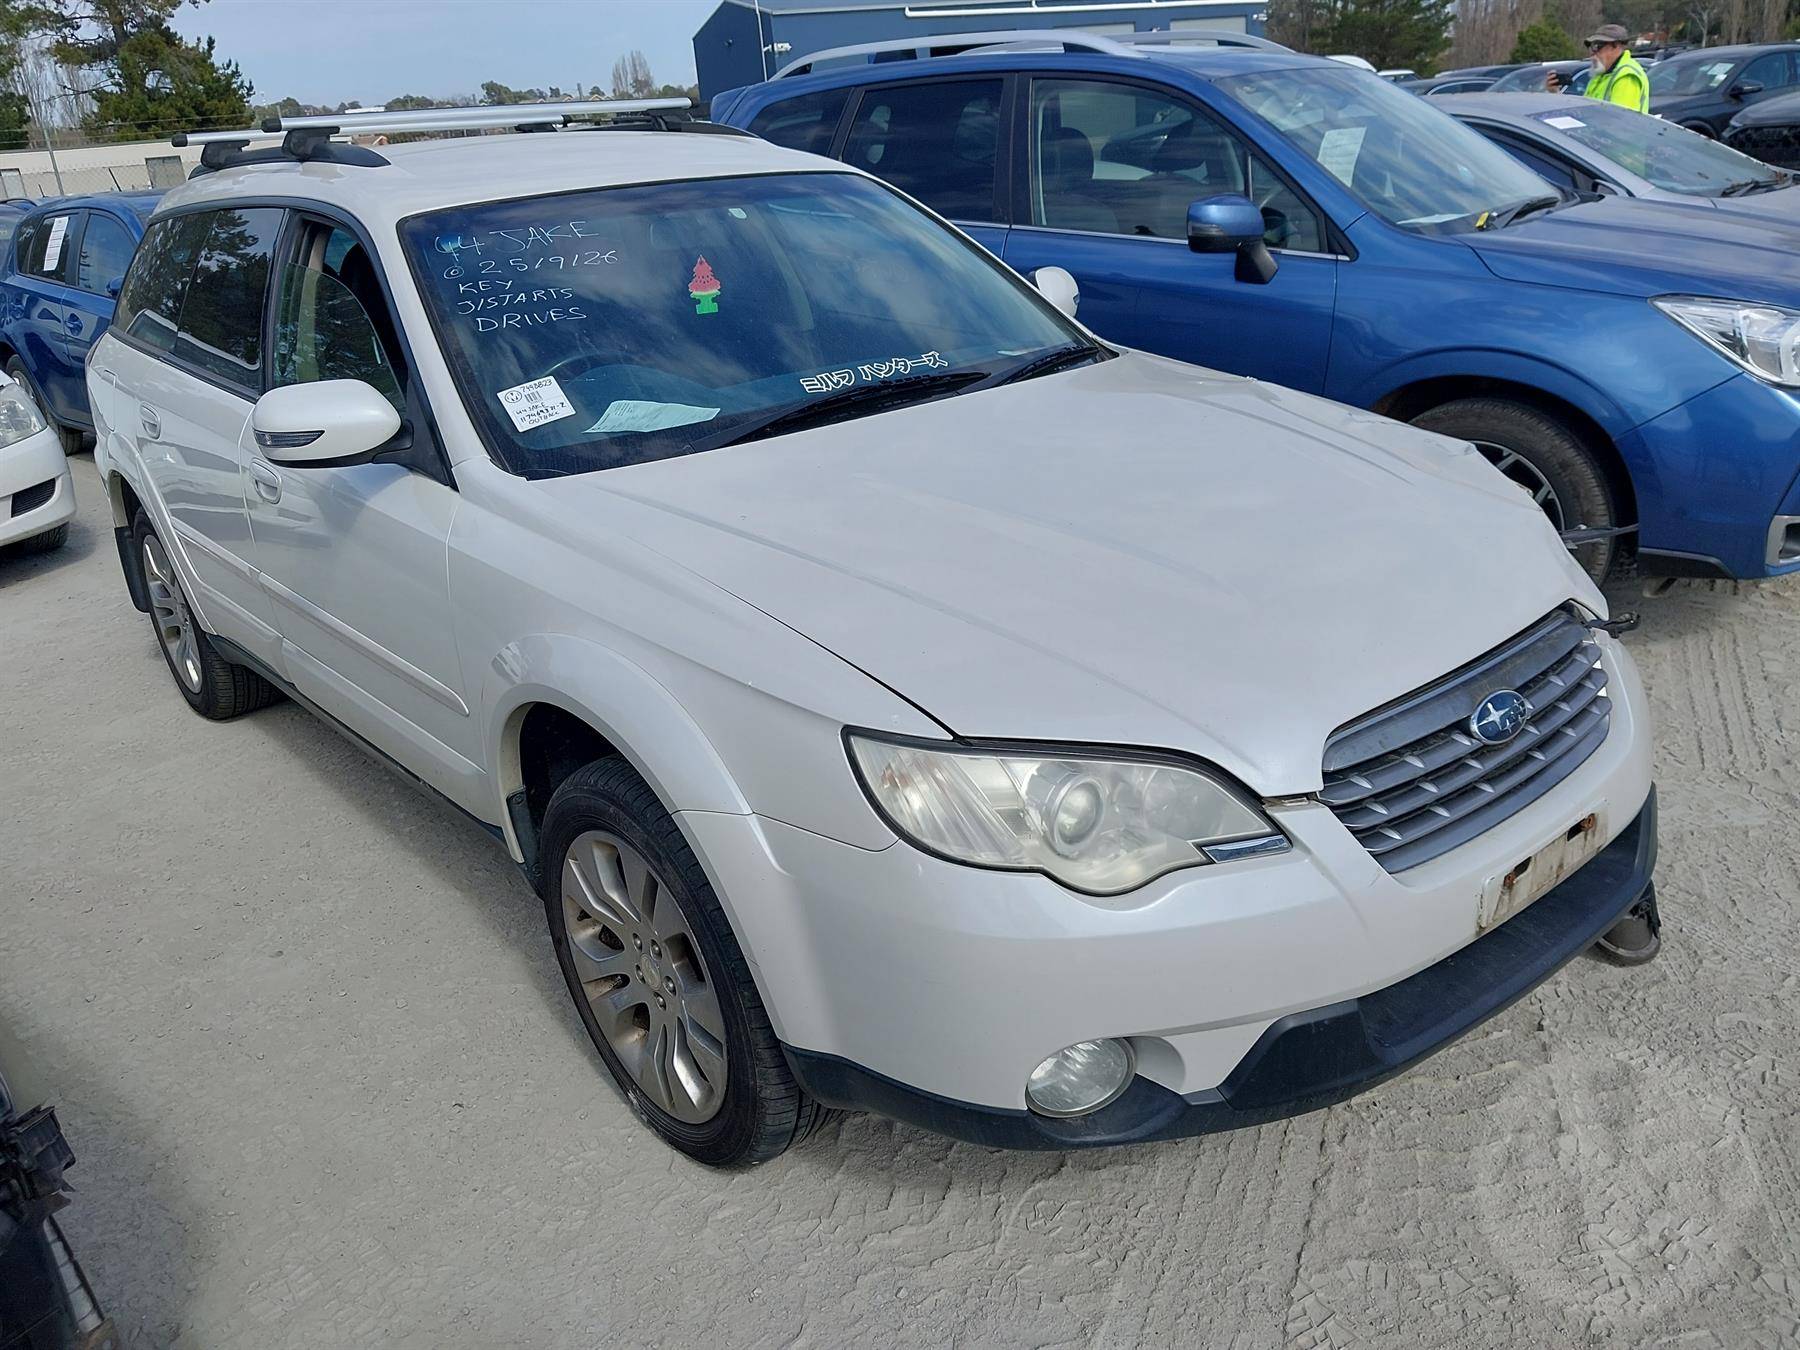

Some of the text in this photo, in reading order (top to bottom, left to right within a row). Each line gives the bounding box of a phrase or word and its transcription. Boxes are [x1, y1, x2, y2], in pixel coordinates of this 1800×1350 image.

[489, 221, 600, 252] JAKE
[458, 279, 513, 294] KEY
[476, 306, 587, 332] DRIVES
[858, 351, 948, 381] ハンターズ
